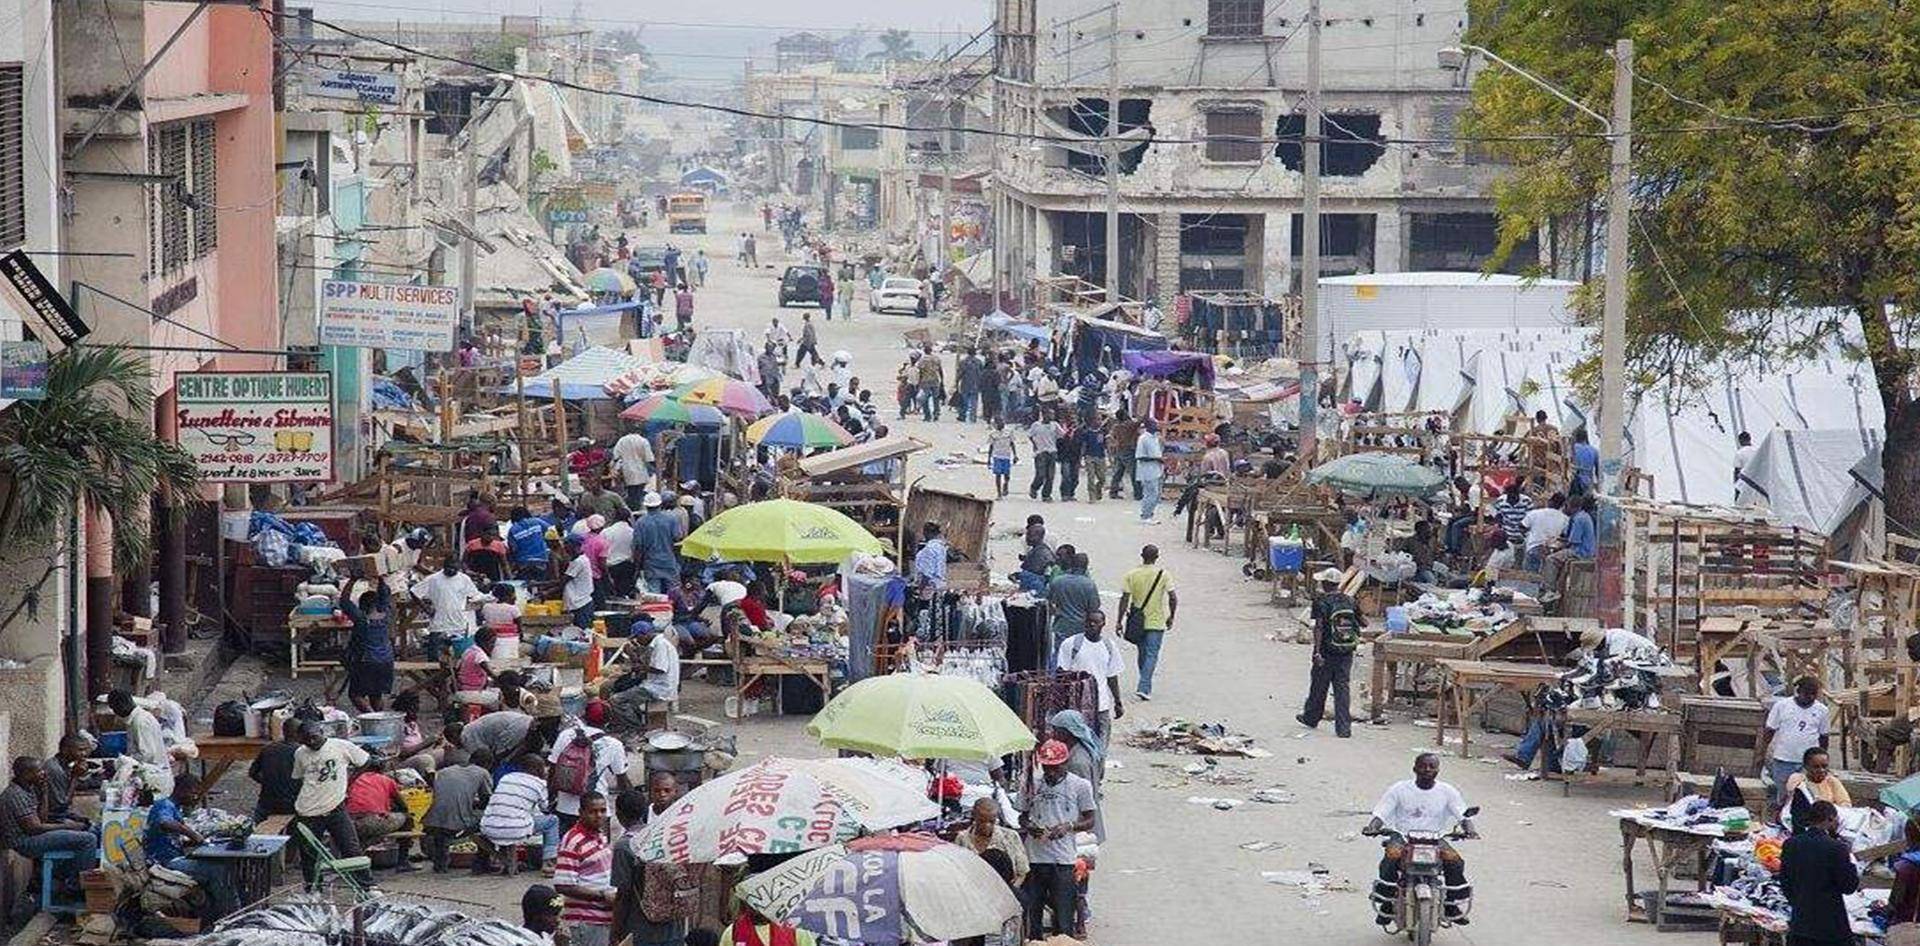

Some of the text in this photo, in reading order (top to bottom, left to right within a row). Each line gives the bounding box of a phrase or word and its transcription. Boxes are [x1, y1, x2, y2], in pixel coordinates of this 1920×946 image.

[325, 283, 357, 298] SPP
[395, 287, 454, 305] SERVICES
[179, 377, 329, 399] CENTRE OPTIQUE HUBERT
